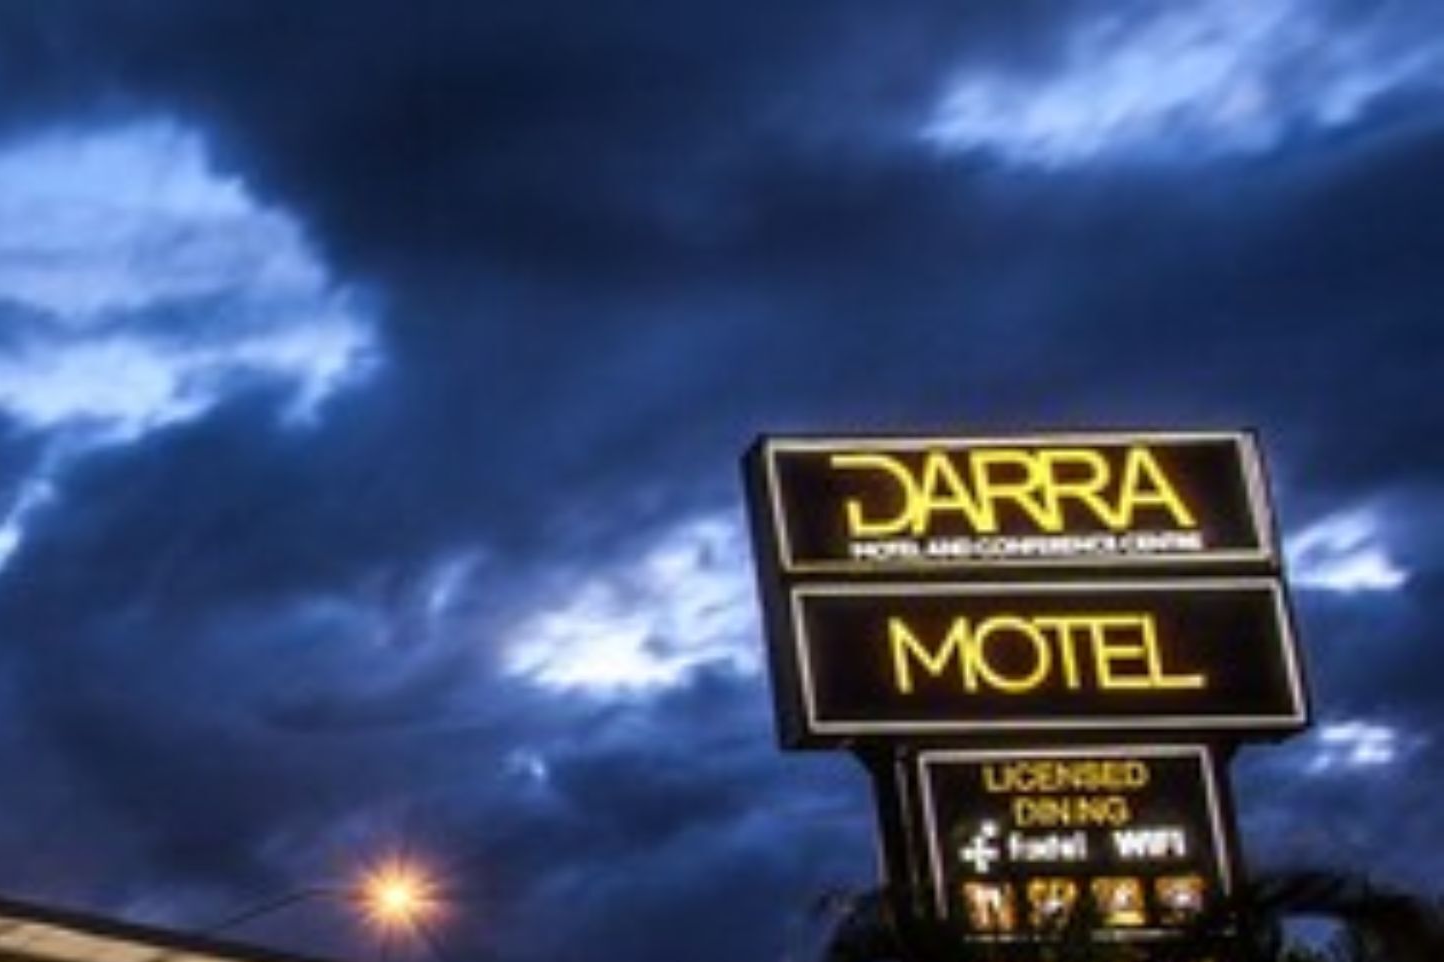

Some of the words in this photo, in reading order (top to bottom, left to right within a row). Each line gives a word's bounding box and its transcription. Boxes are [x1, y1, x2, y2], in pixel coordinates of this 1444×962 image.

[831, 445, 1197, 536] DARRA
[888, 613, 1205, 693] MOTEL
[982, 760, 1149, 792] LICENSED
[1013, 795, 1131, 827] DINING
